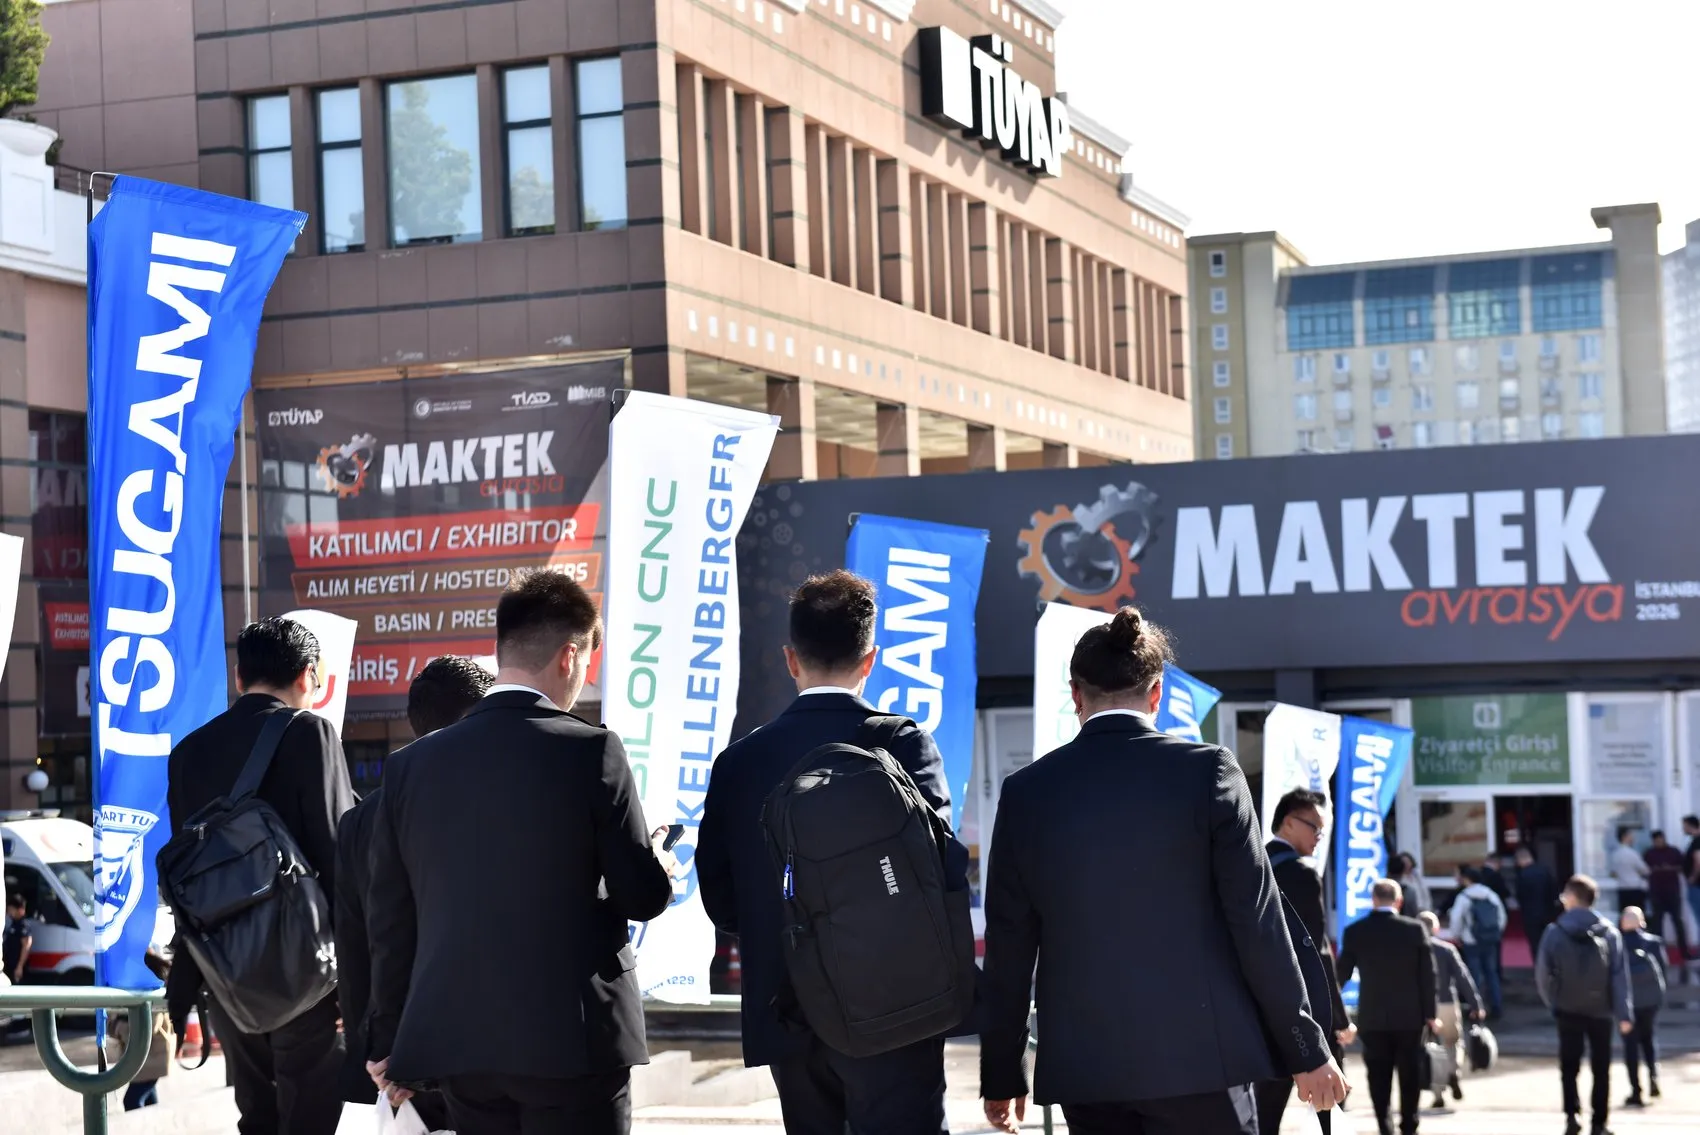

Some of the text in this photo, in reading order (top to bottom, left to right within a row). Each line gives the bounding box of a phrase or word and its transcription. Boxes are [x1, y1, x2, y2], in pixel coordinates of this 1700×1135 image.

[972, 33, 1070, 178] TÜYAP
[381, 431, 556, 489] MAKTEK
[98, 232, 237, 764] TSUGAMI
[309, 527, 423, 558] KATILIMCI
[446, 518, 578, 549] EXHIBITOR
[637, 477, 678, 603] CNC
[1172, 485, 1611, 599] MAKTEK
[307, 578, 350, 598] ALIM
[354, 569, 416, 596] HEYETİ
[434, 567, 510, 590] HOSTED
[514, 562, 588, 582] ERS
[374, 612, 431, 633] BASIN
[675, 433, 742, 828] KELLENBERGER
[1401, 583, 1625, 641] avrasya
[1636, 603, 1680, 621] 2026
[131, 814, 156, 828] TU
[1346, 734, 1394, 917] TSUGAMI
[879, 855, 899, 895] THULE
